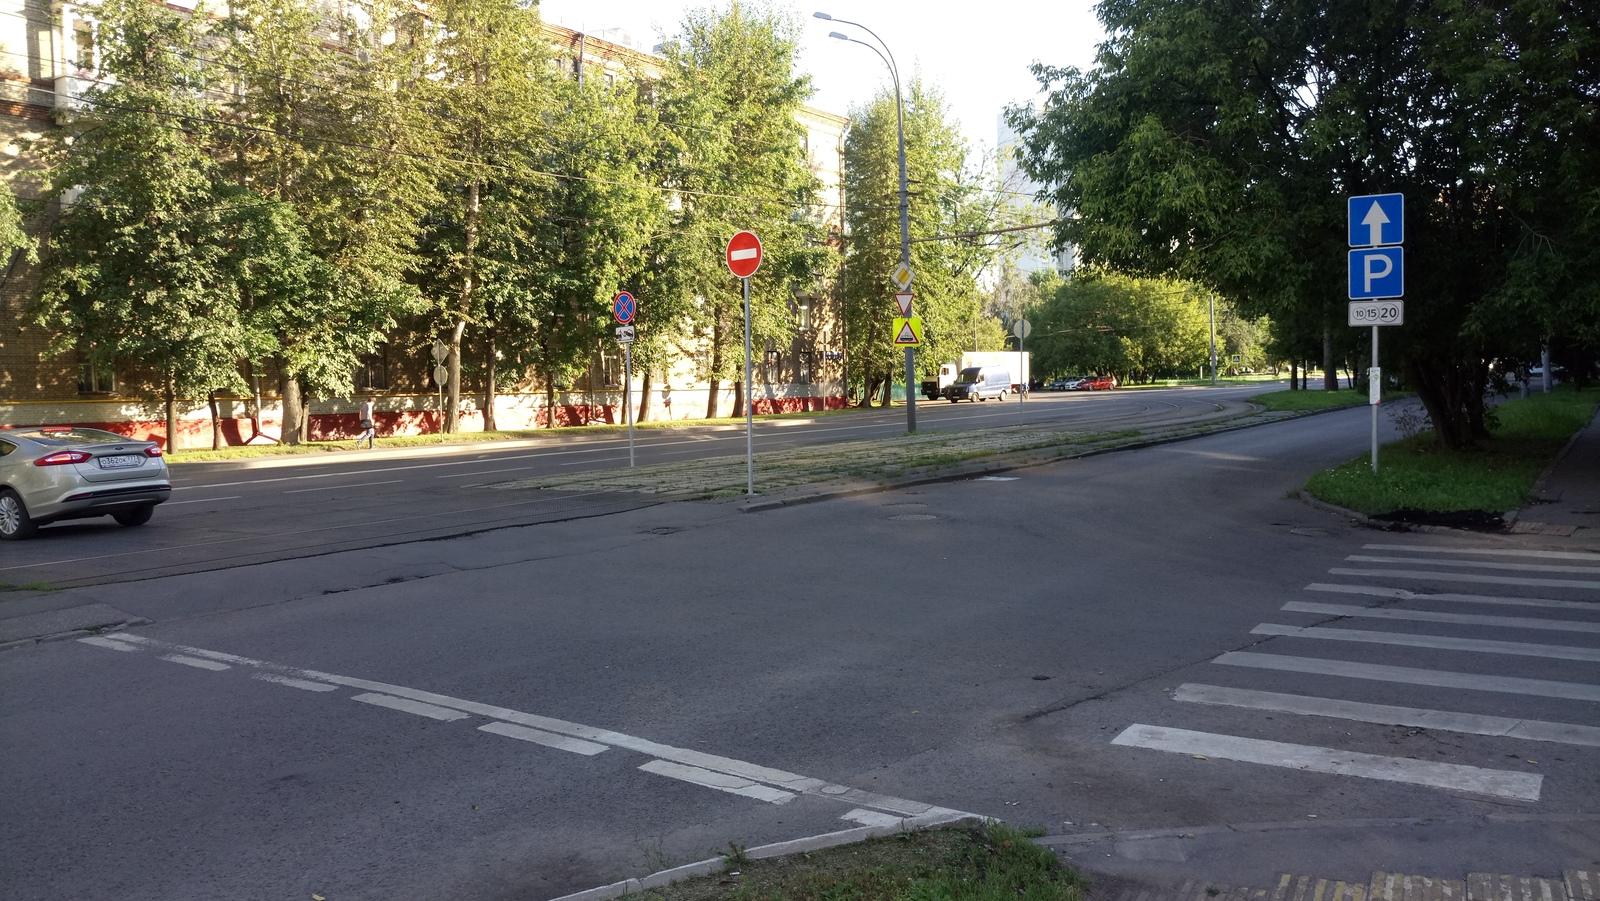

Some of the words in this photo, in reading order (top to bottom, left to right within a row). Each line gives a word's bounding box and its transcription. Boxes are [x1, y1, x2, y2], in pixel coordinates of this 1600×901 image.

[1364, 254, 1393, 293] P
[1367, 309, 1377, 317] 15
[1381, 307, 1397, 318] 20
